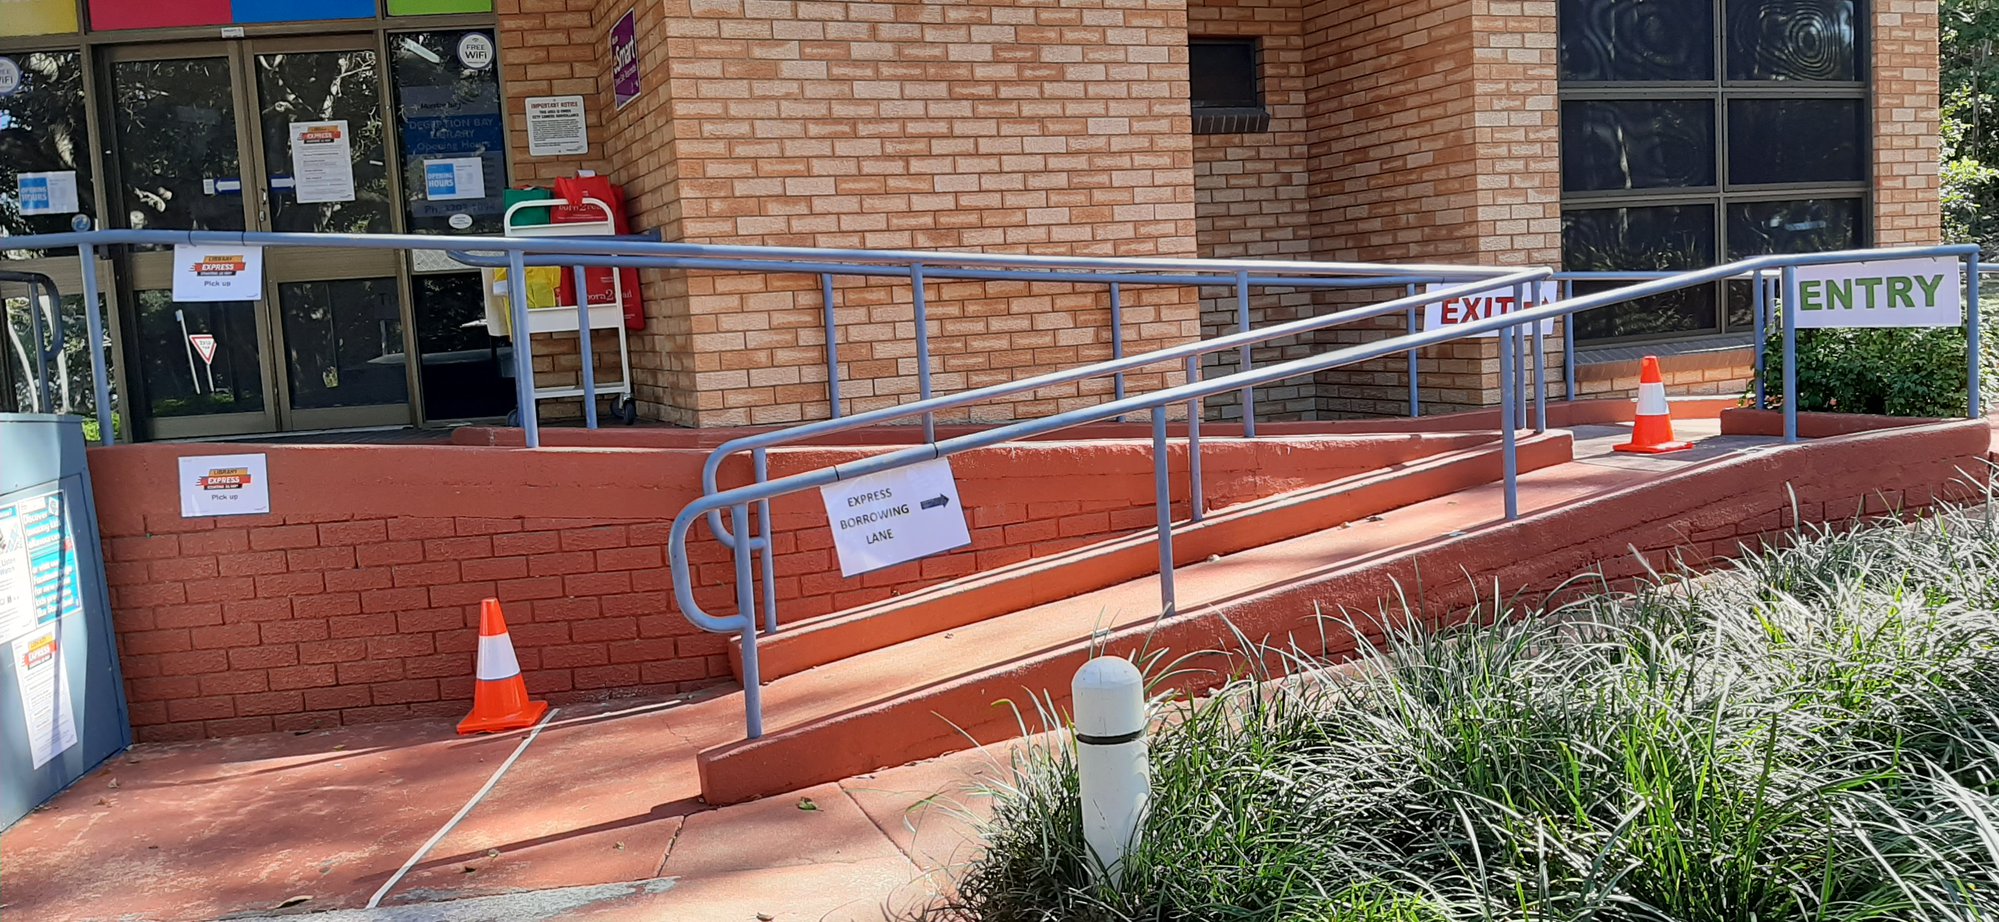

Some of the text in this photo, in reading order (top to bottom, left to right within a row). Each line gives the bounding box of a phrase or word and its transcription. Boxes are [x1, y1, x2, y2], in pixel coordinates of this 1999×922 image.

[473, 118, 494, 127] BAY
[428, 179, 454, 187] HOURS
[202, 263, 235, 271] EXPRESS
[1799, 274, 1945, 311] ENTRY
[1441, 296, 1516, 325] EXIT
[208, 476, 240, 485] EXPRESS
[847, 487, 893, 507] EXPRESS
[840, 503, 910, 530] BORROWING
[866, 528, 894, 545] LANE
